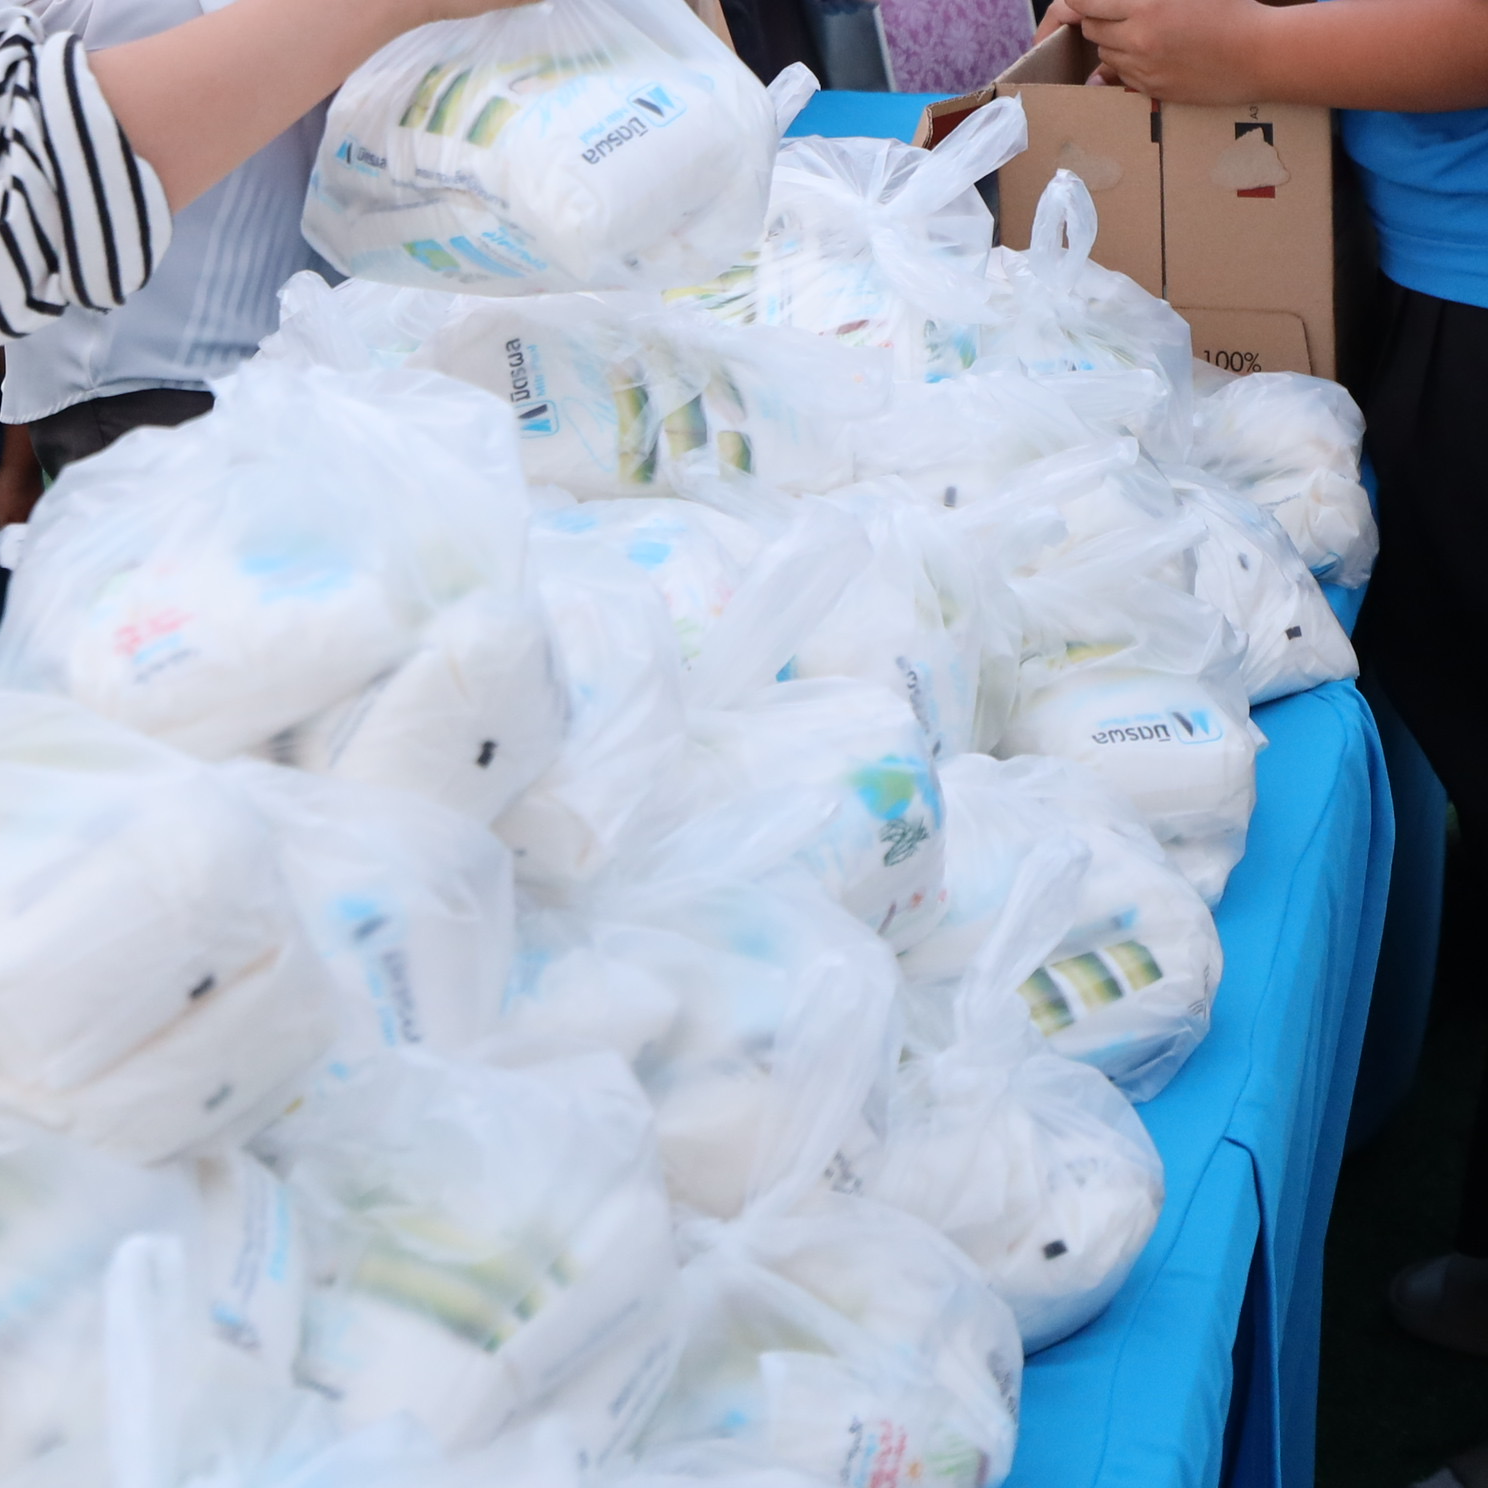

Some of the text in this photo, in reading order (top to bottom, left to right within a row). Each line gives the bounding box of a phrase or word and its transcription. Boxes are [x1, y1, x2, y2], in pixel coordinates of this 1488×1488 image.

[580, 116, 649, 166] มิตรผล
[505, 337, 531, 403] มิตรผล
[1203, 350, 1262, 373] 100%
[1092, 723, 1172, 746] มิตรผล
